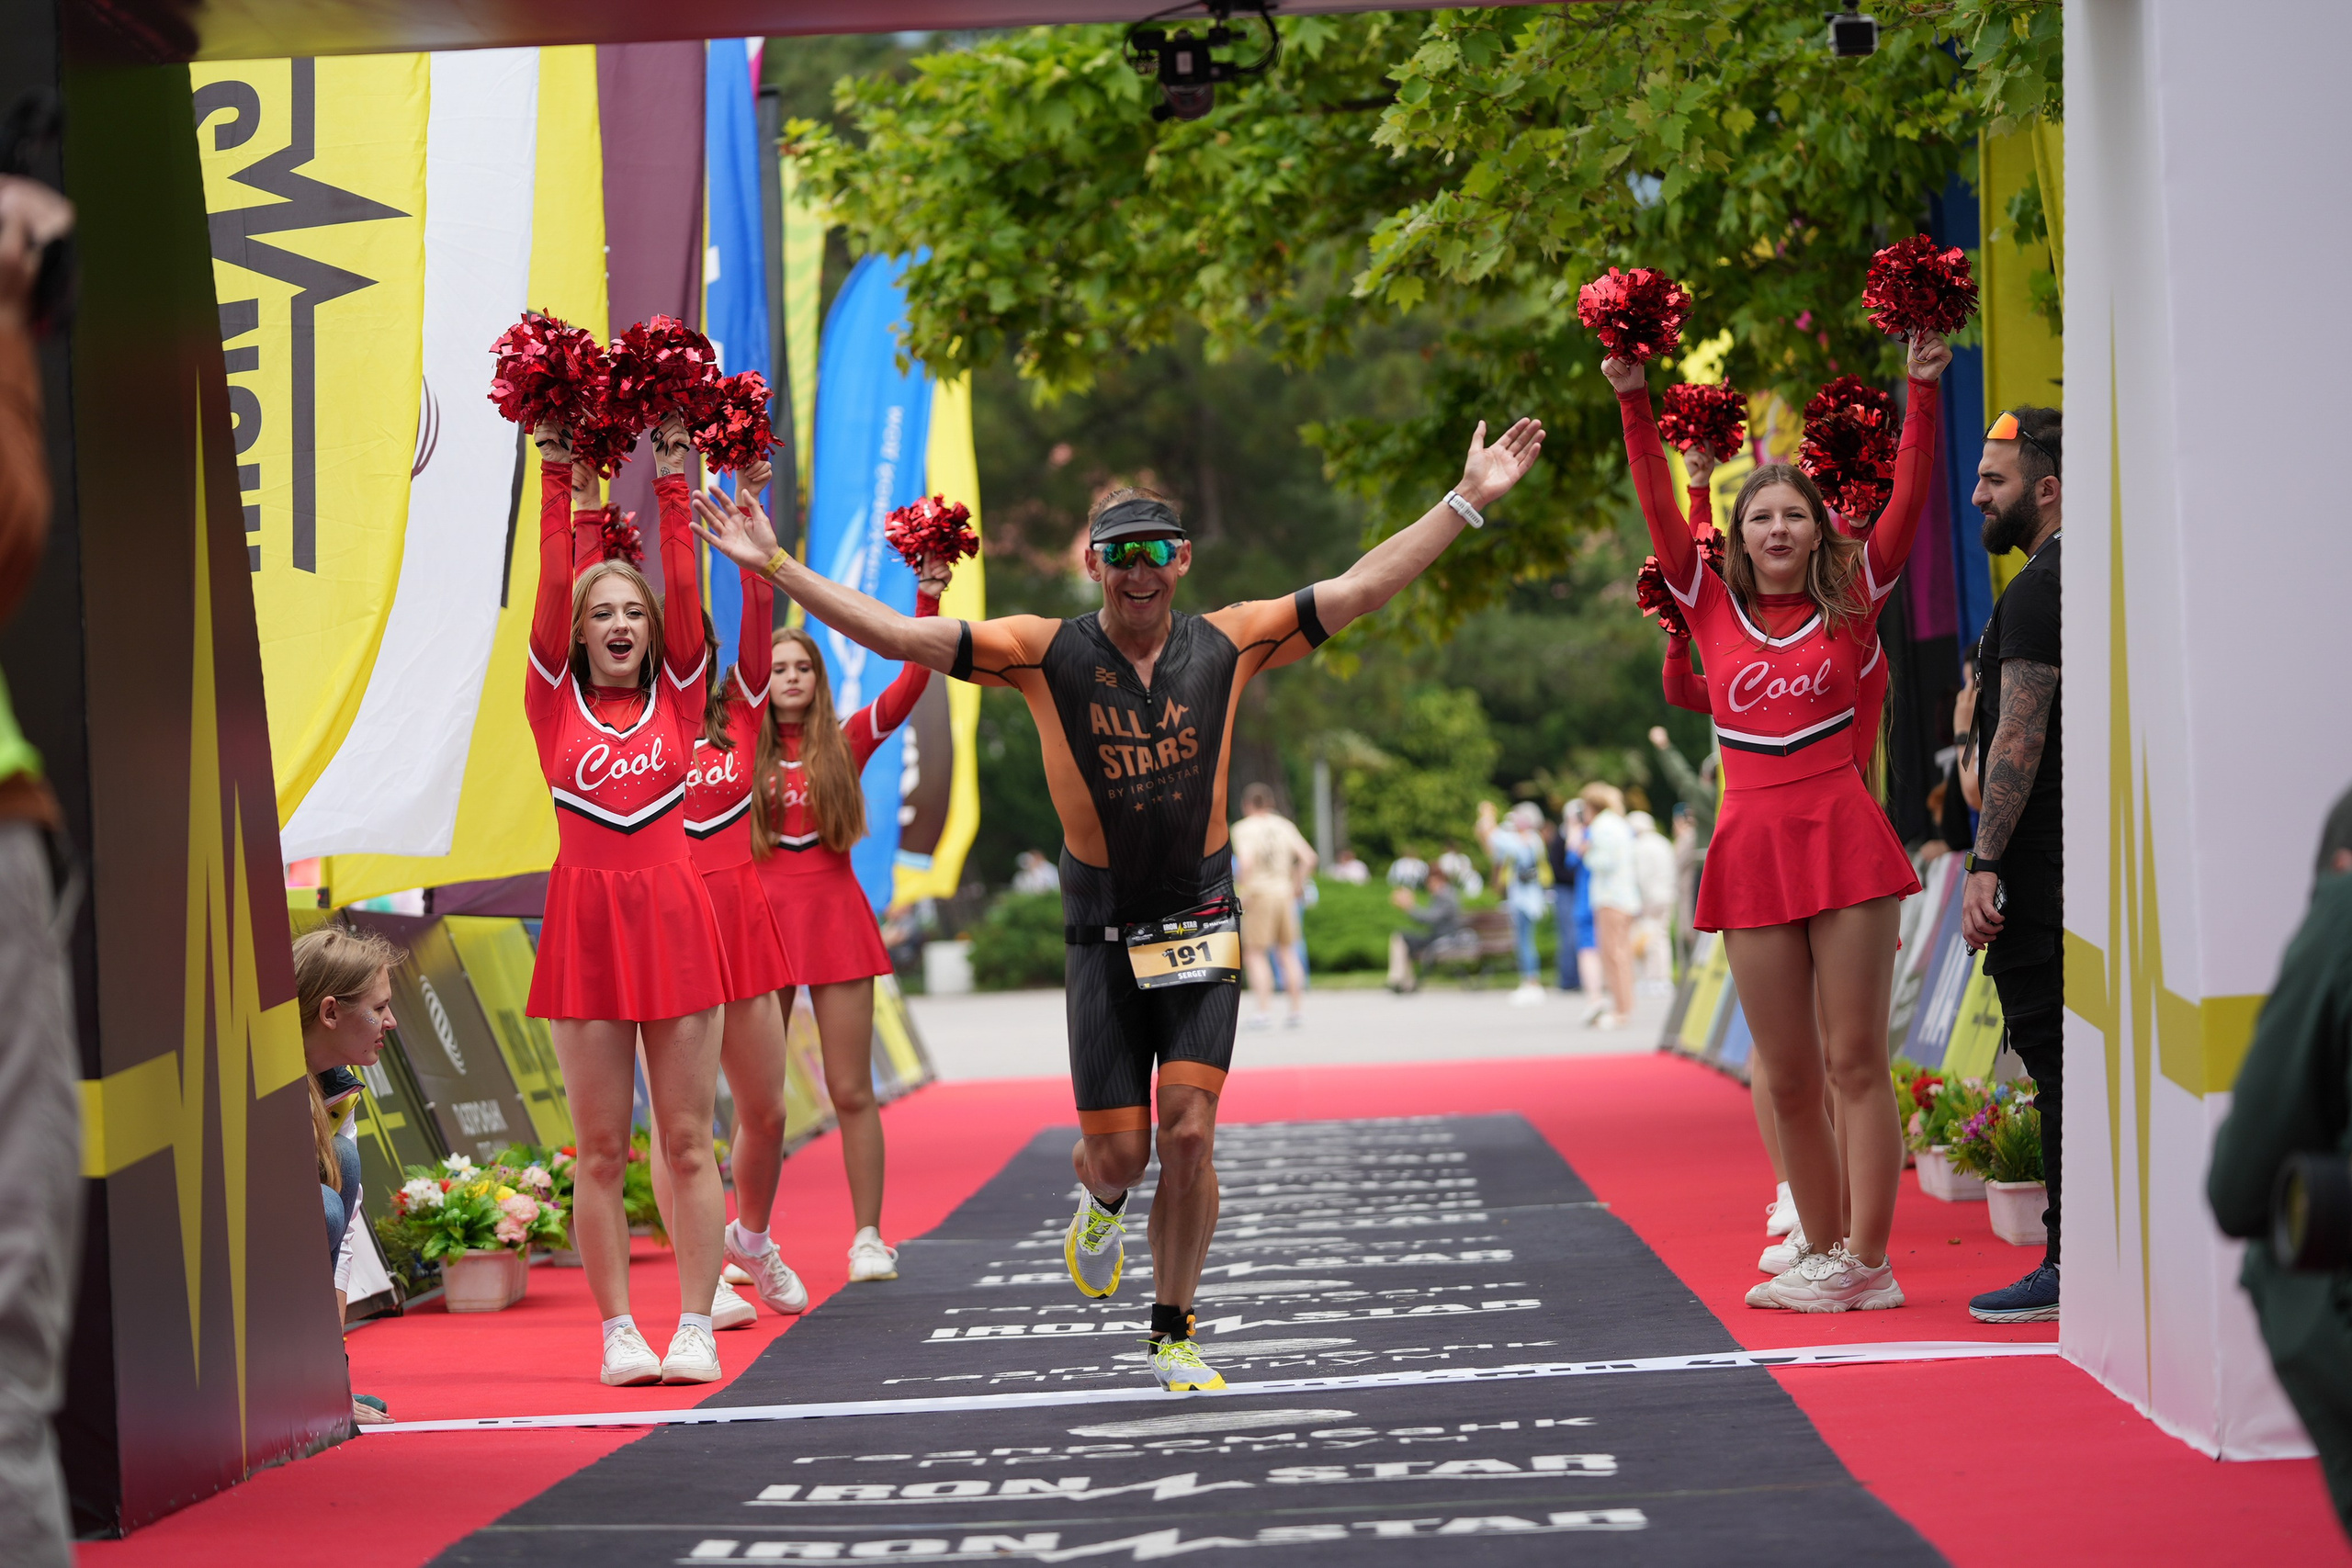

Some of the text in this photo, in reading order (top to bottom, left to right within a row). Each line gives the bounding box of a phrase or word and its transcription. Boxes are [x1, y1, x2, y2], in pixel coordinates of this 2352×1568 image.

[880, 406, 904, 462] ДОМ
[1728, 658, 1831, 713] Cool
[1090, 702, 1152, 739] ALL
[575, 737, 666, 791] Cool
[686, 751, 739, 785] ool
[1098, 727, 1199, 780] STARS
[1108, 765, 1200, 799] BY IRONSTAR
[1162, 922, 1178, 931] IRON
[1182, 920, 1198, 929] STAR
[1161, 942, 1212, 967] 191
[1178, 969, 1207, 980] SERGEY
[1295, 1249, 1514, 1265] STAR
[930, 1299, 1542, 1338] IRON STAR
[755, 1453, 1618, 1502] IRON STAR
[689, 1507, 1648, 1559] IRON STAR
